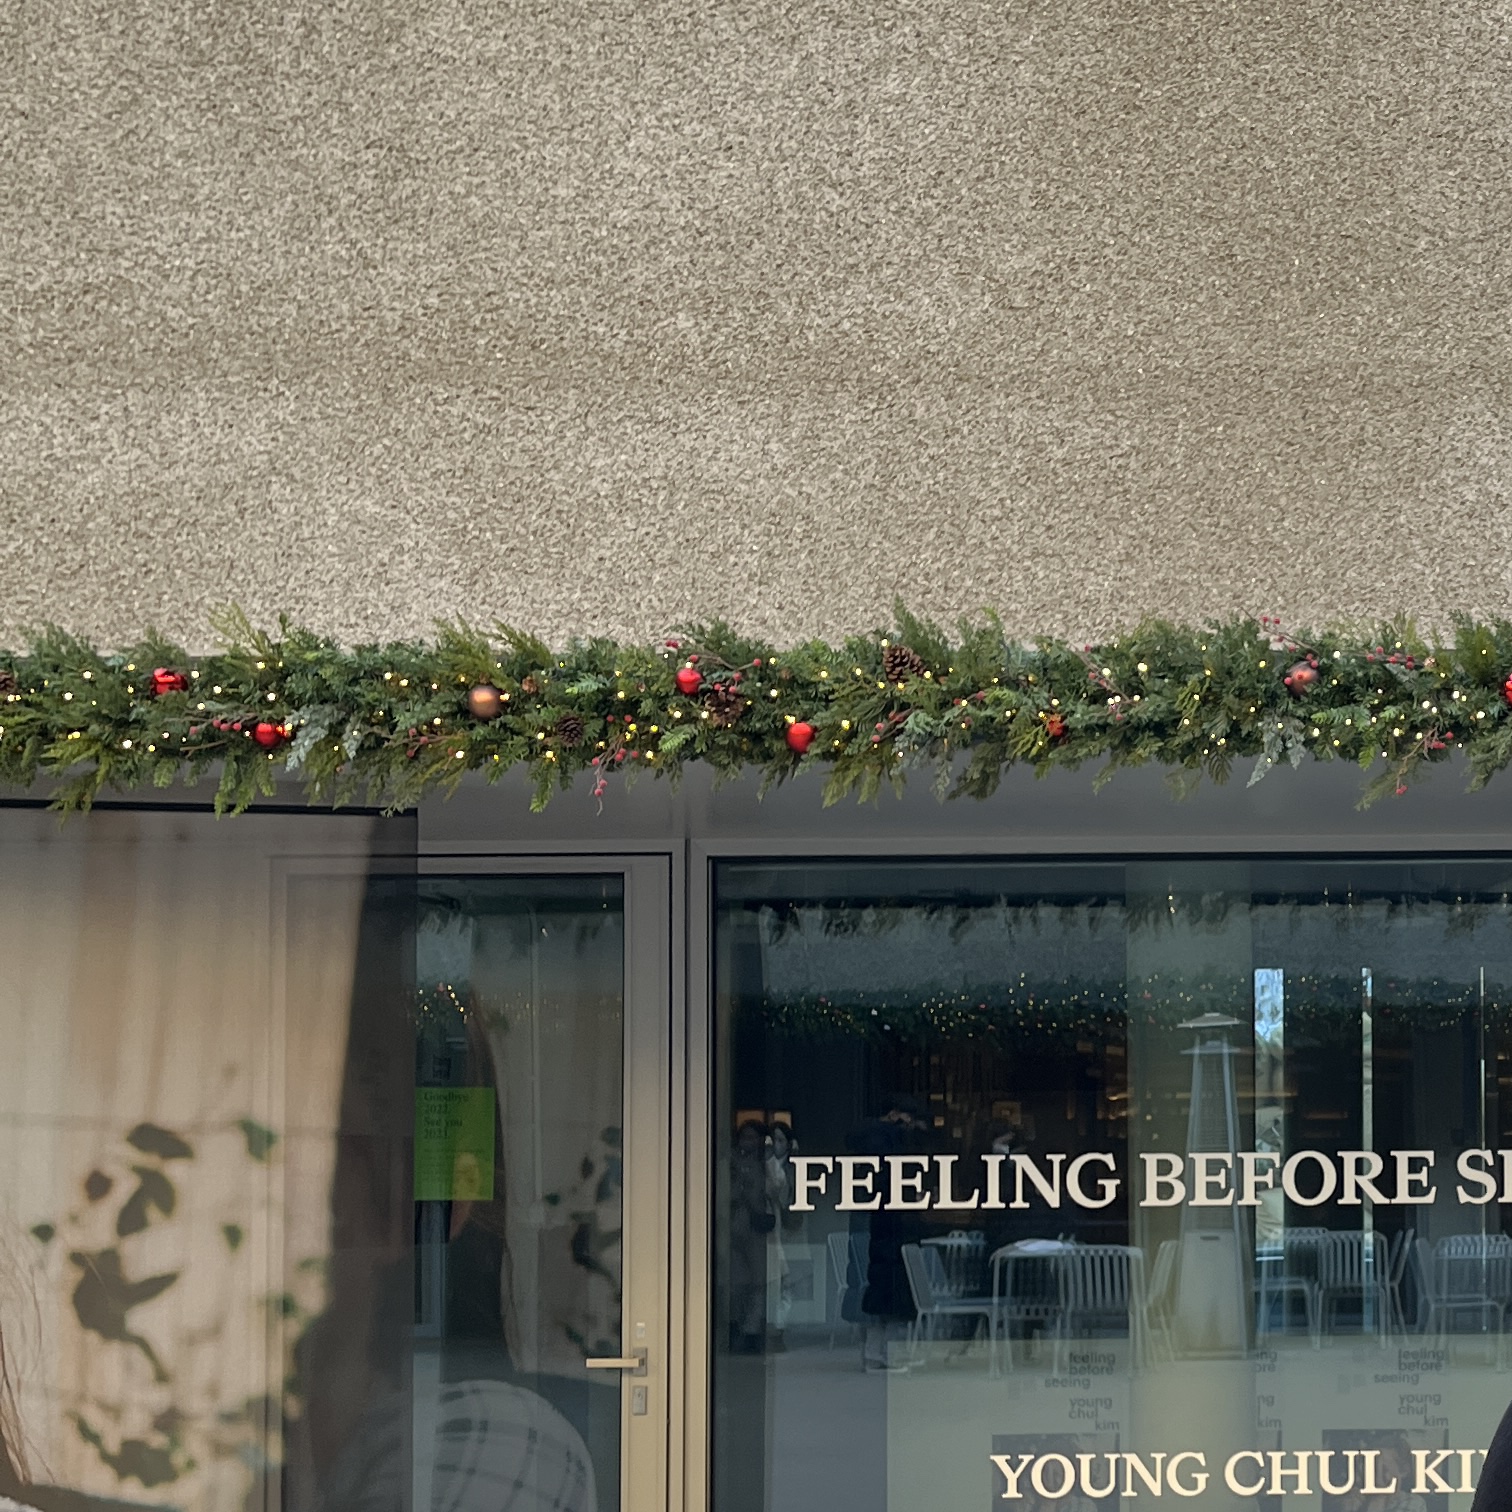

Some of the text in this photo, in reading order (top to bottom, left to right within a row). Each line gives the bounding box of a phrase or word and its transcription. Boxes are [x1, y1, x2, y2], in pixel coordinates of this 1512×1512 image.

[789, 1152, 1121, 1211] FEELING
[1139, 1150, 1437, 1207] BEFORE
[1069, 1352, 1115, 1365] feeling
[1398, 1348, 1444, 1361] feeling
[1068, 1364, 1114, 1375] before
[1398, 1359, 1443, 1371] before
[1044, 1378, 1091, 1389] seeing
[1374, 1373, 1420, 1385] seeing
[1069, 1397, 1112, 1409] young
[1400, 1393, 1442, 1405] young
[1068, 1407, 1098, 1419] chul
[1398, 1403, 1428, 1415] chul
[1095, 1420, 1119, 1431] kim
[1256, 1416, 1282, 1429] kim
[1424, 1415, 1448, 1426] kim
[990, 1449, 1489, 1498] YOUNG CHUL KI
